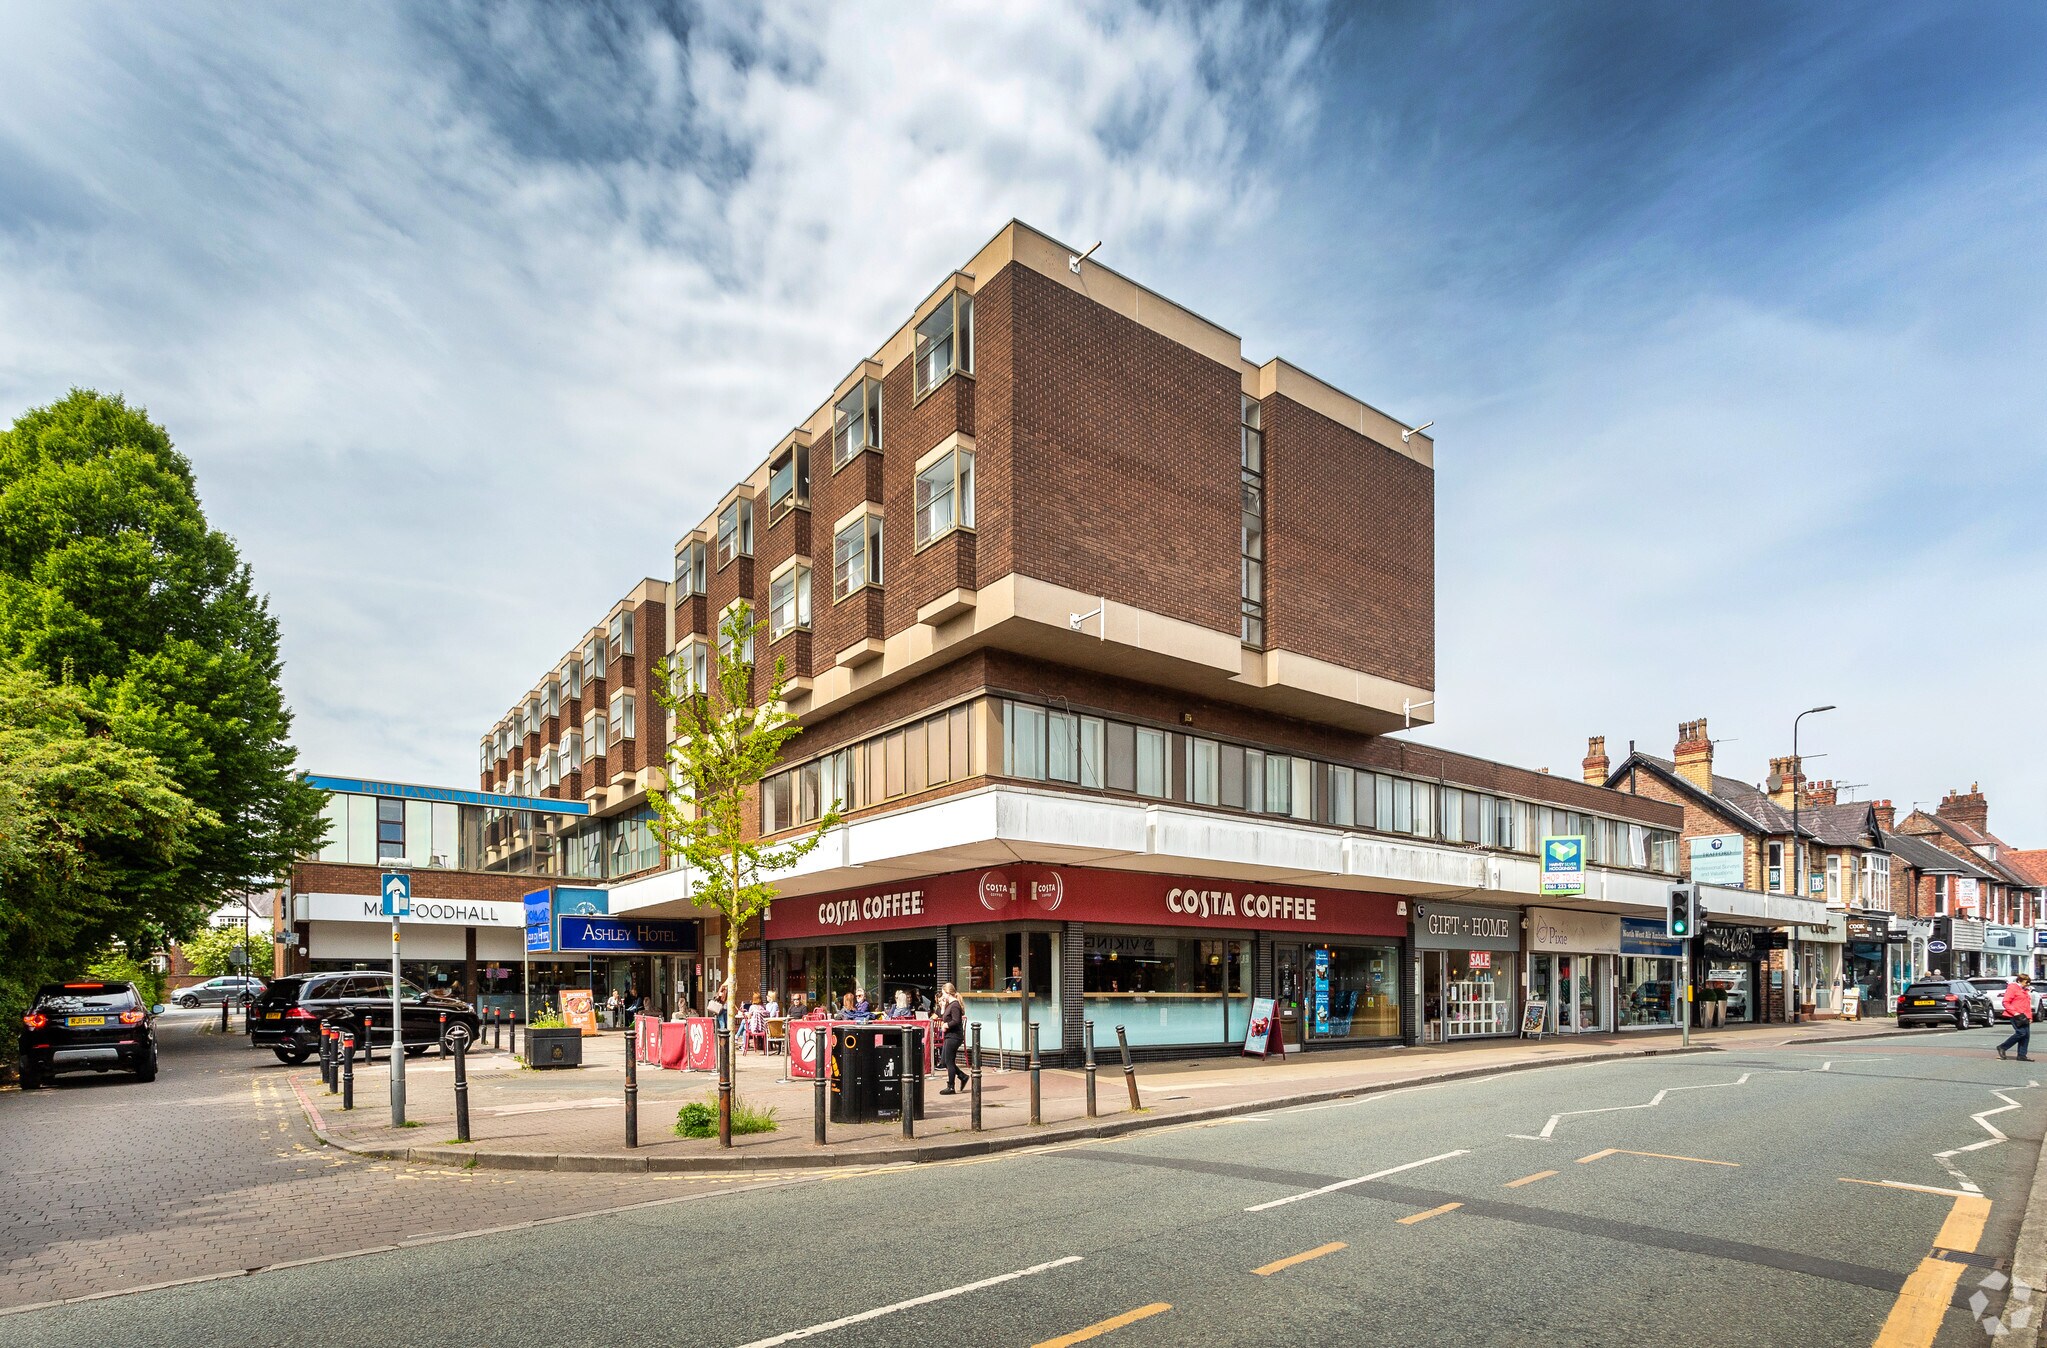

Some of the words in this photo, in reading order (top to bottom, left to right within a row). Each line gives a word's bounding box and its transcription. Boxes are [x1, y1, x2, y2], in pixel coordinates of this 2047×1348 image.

[361, 780, 470, 803] BRITANNIA
[476, 793, 538, 809] HOTEL
[1542, 873, 1560, 882] SHOP
[1562, 873, 1571, 882] TO
[1572, 873, 1584, 882] LET
[985, 883, 1008, 892] COSTA
[1037, 883, 1056, 892] COSTA
[818, 898, 862, 926] COSTA
[862, 890, 924, 920] COFFEE
[1166, 887, 1236, 919] COSTA
[1241, 893, 1317, 921] COFFEE
[1428, 914, 1460, 935] GIFT
[1462, 920, 1469, 932] +
[1471, 917, 1509, 938] HOME
[394, 933, 400, 942] 2
[1549, 926, 1568, 946] Pixie
[1622, 929, 1634, 938] North
[1634, 930, 1645, 938] West
[1470, 953, 1490, 966] SALE
